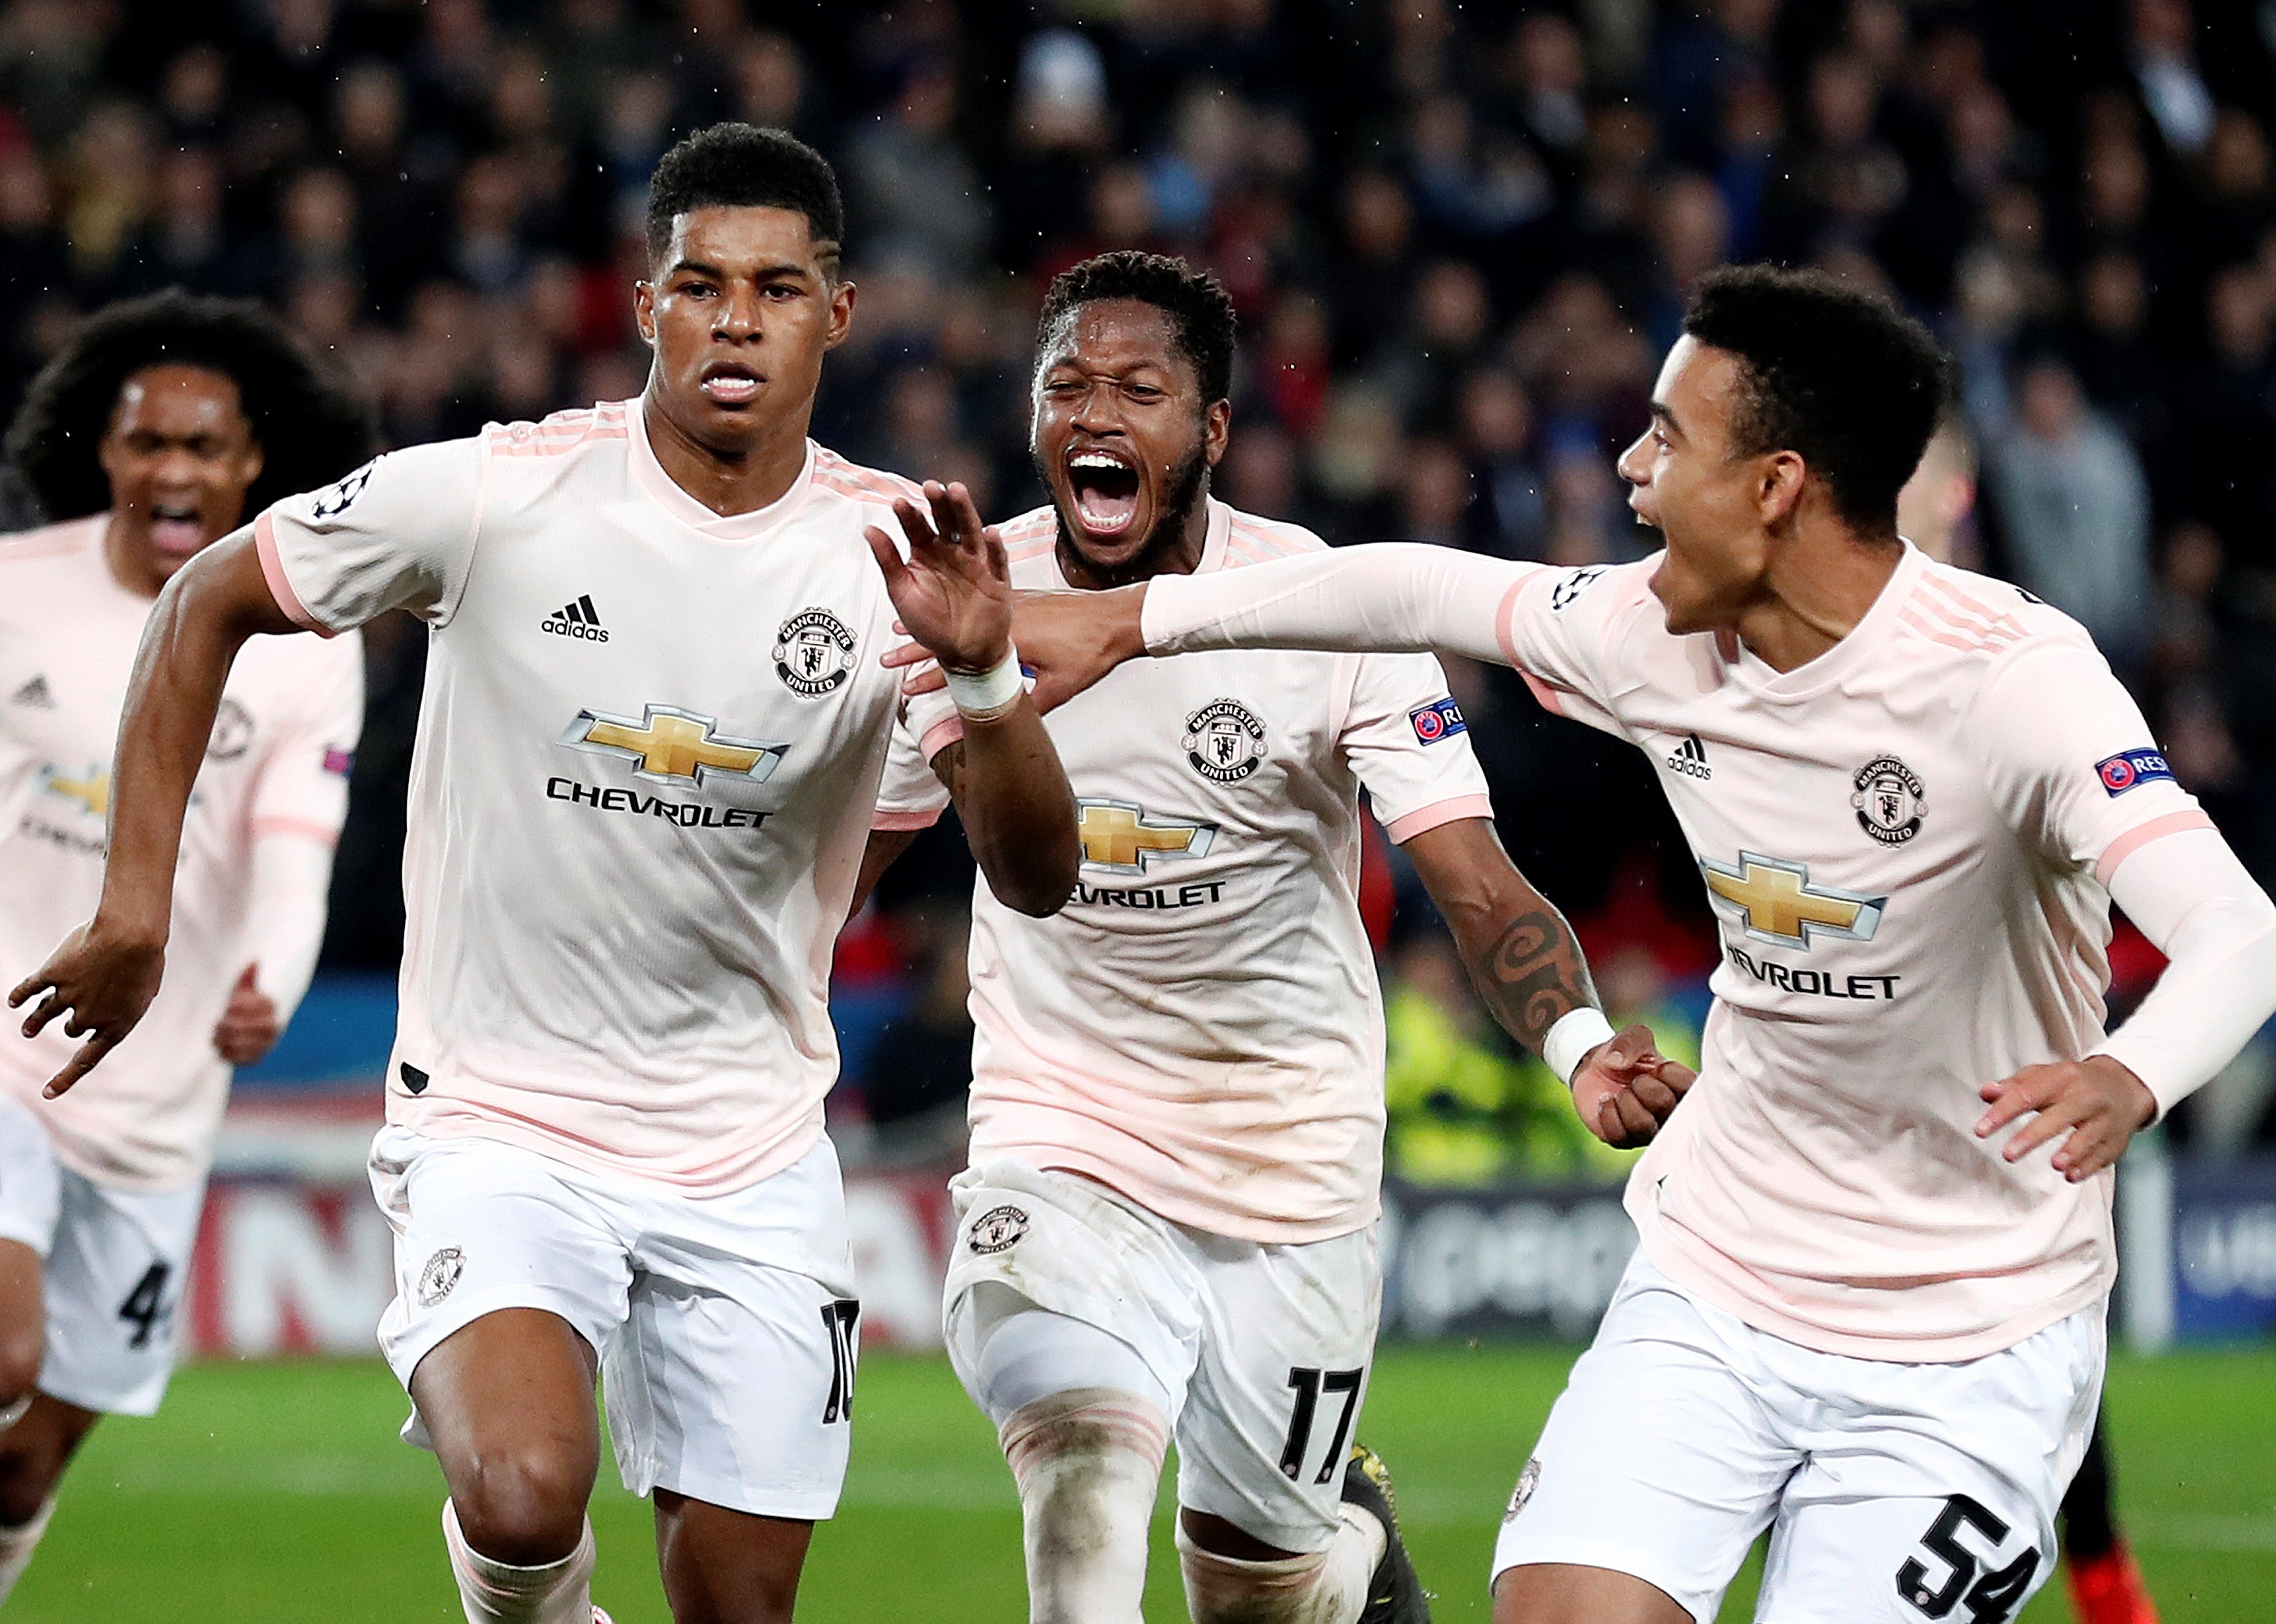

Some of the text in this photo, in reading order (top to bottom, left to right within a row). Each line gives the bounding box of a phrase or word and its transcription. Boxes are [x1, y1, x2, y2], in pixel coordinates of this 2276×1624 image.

[541, 620, 609, 642] adidas
[782, 613, 851, 648] MANCHESTER
[786, 674, 835, 693] UNITED
[1192, 704, 1260, 736] MANCHESTER
[1200, 763, 1248, 780] UNITED
[1668, 757, 1713, 780] adidas
[1858, 761, 1921, 795] MANCHESTER
[547, 777, 774, 828] CHEVROLET
[1868, 823, 1912, 841] UNITED
[1279, 1367, 1364, 1484] 17
